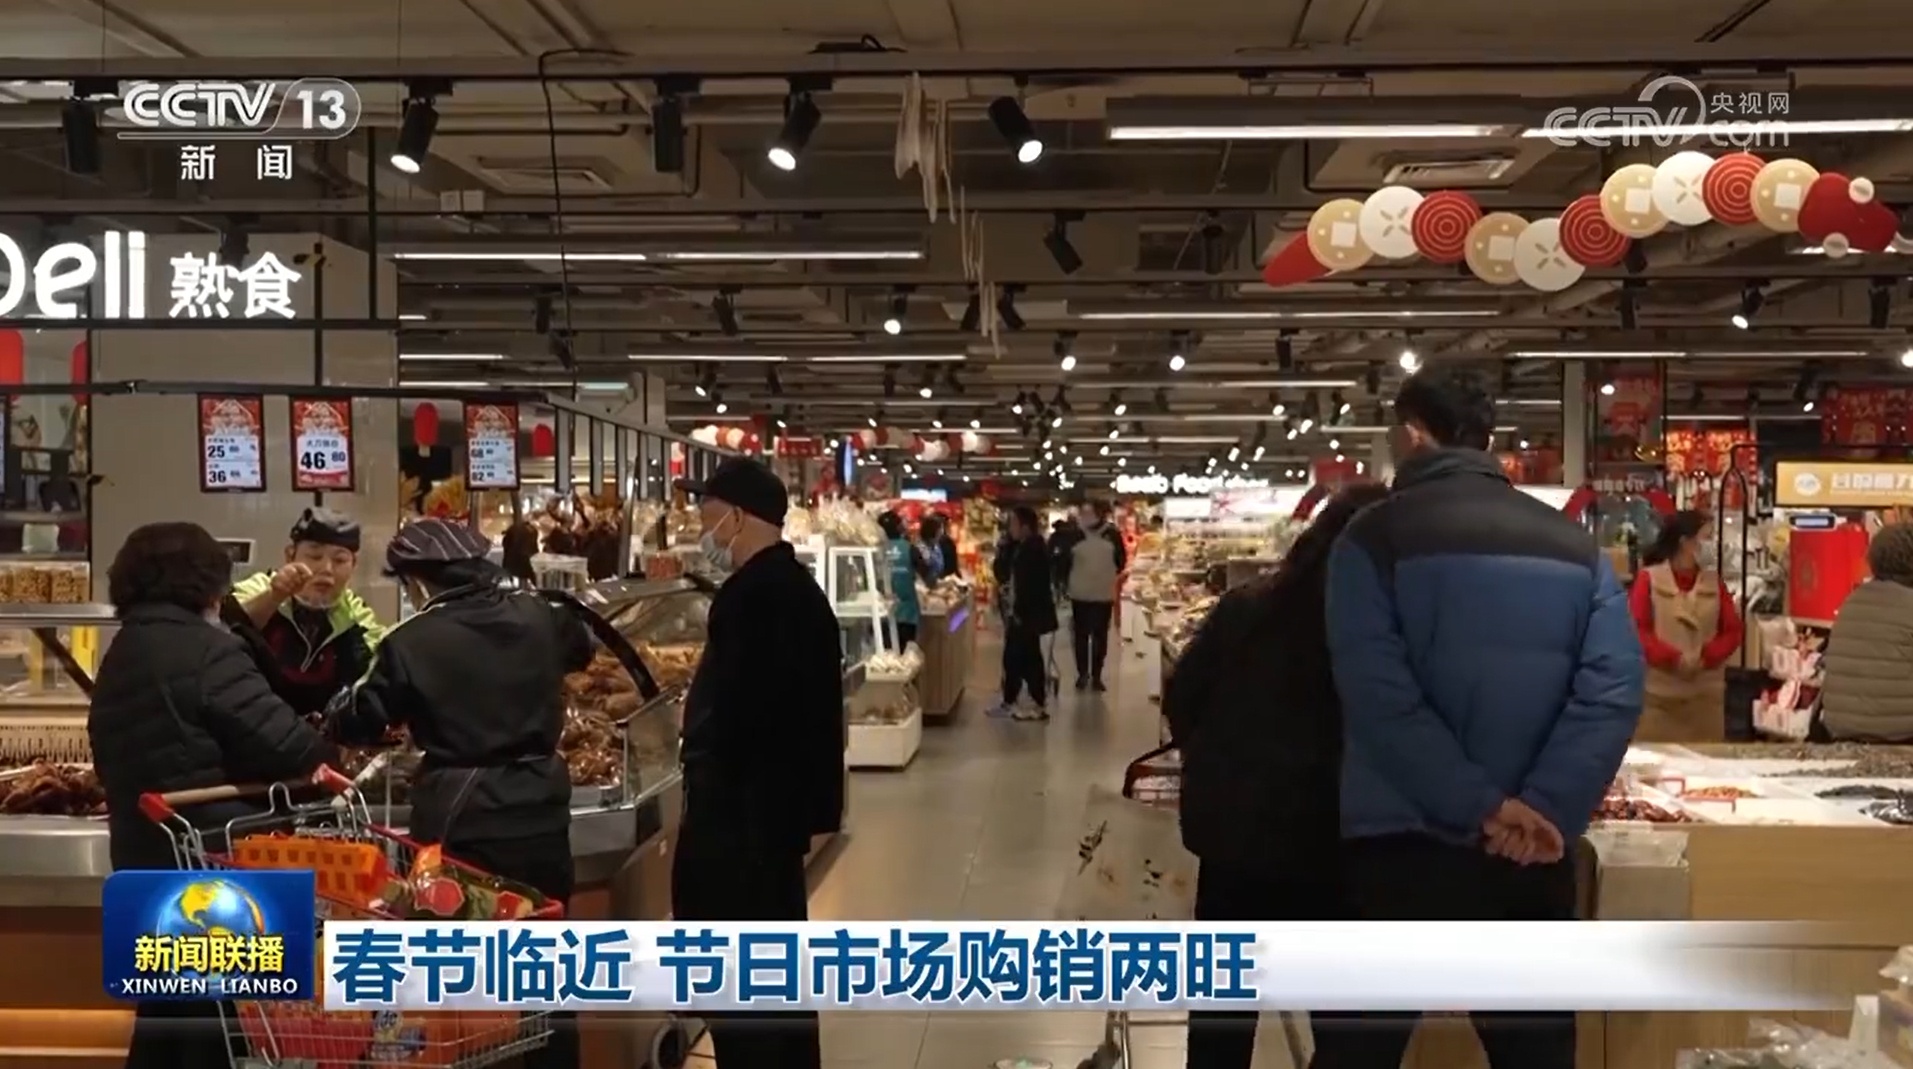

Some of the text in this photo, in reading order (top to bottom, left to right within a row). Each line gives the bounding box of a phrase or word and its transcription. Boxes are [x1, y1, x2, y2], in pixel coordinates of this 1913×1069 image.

[169, 251, 301, 318] 熟食
[208, 445, 225, 458] 25
[301, 452, 325, 469] 46
[208, 470, 226, 483] 36
